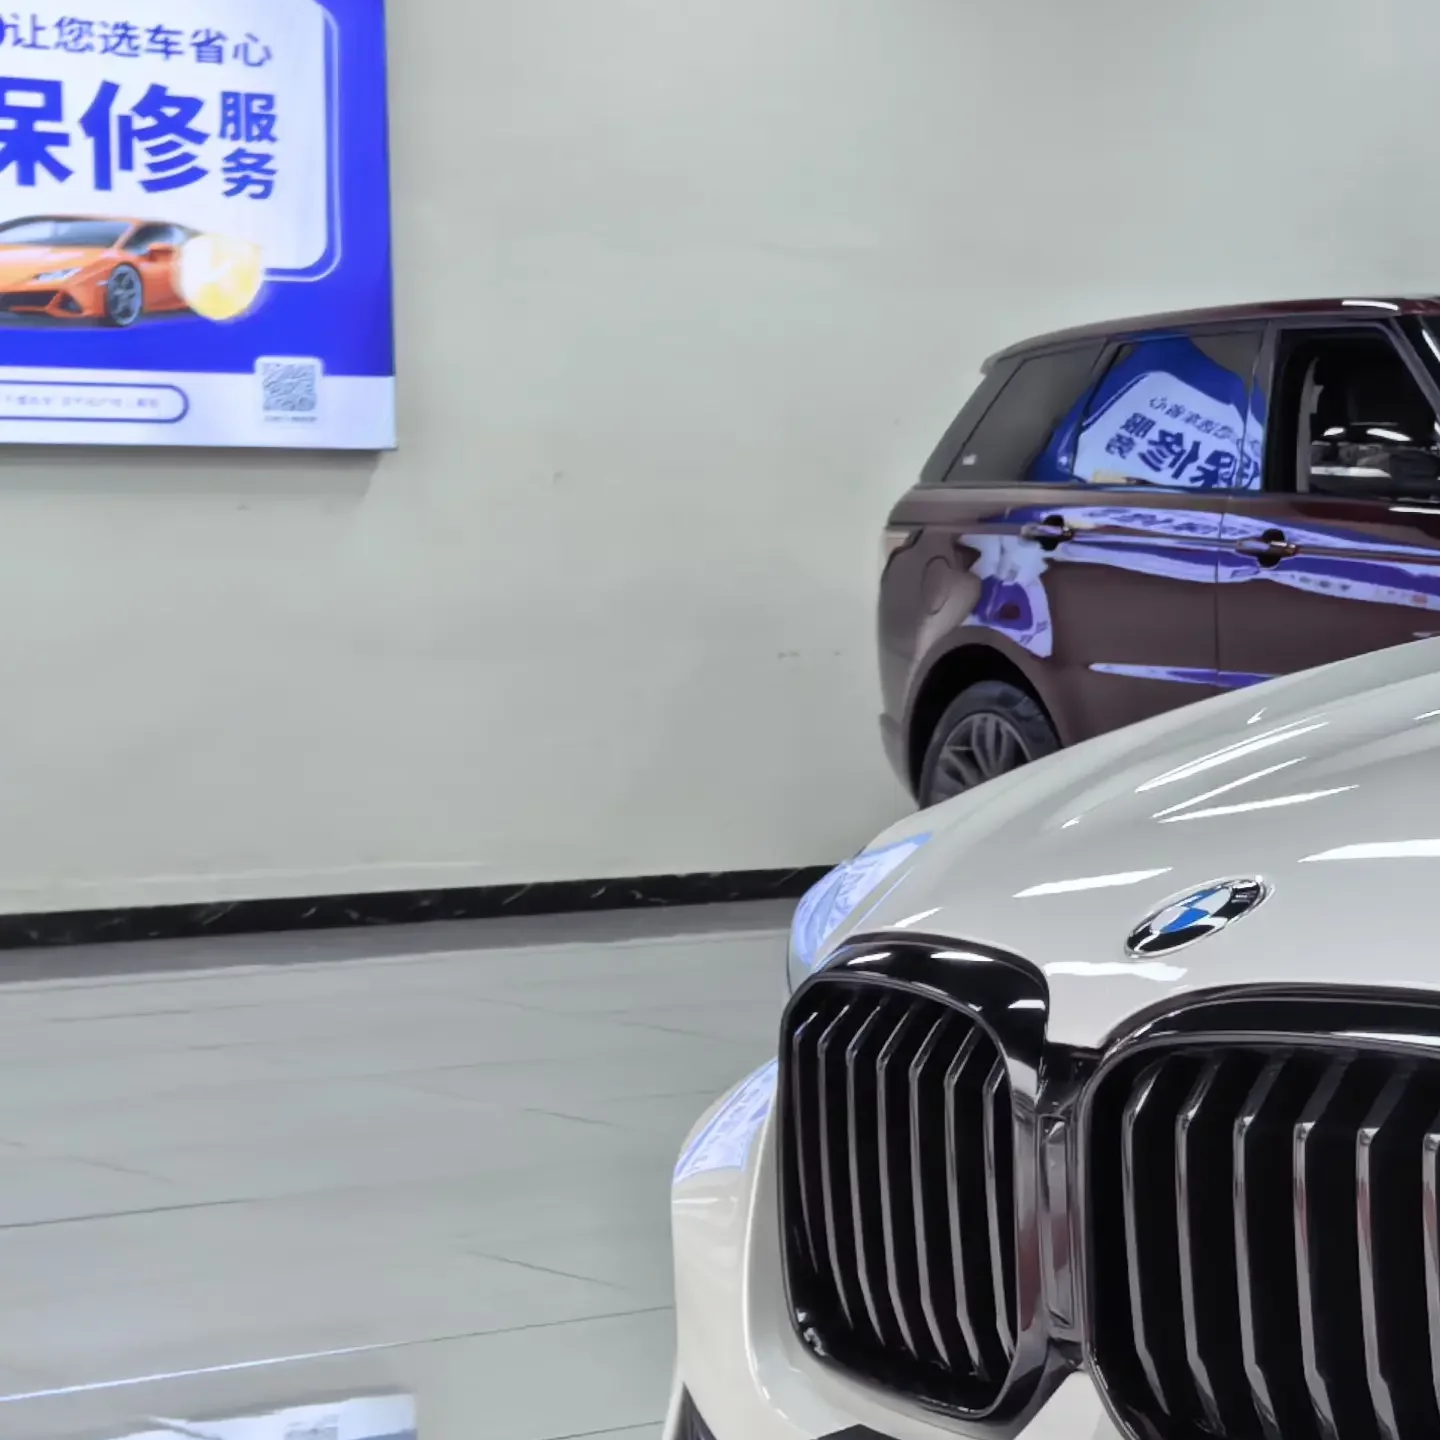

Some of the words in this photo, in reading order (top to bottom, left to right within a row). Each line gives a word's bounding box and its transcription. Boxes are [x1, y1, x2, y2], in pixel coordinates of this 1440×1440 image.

[4, 12, 273, 67] 让您选车省心
[218, 91, 278, 200] 服务
